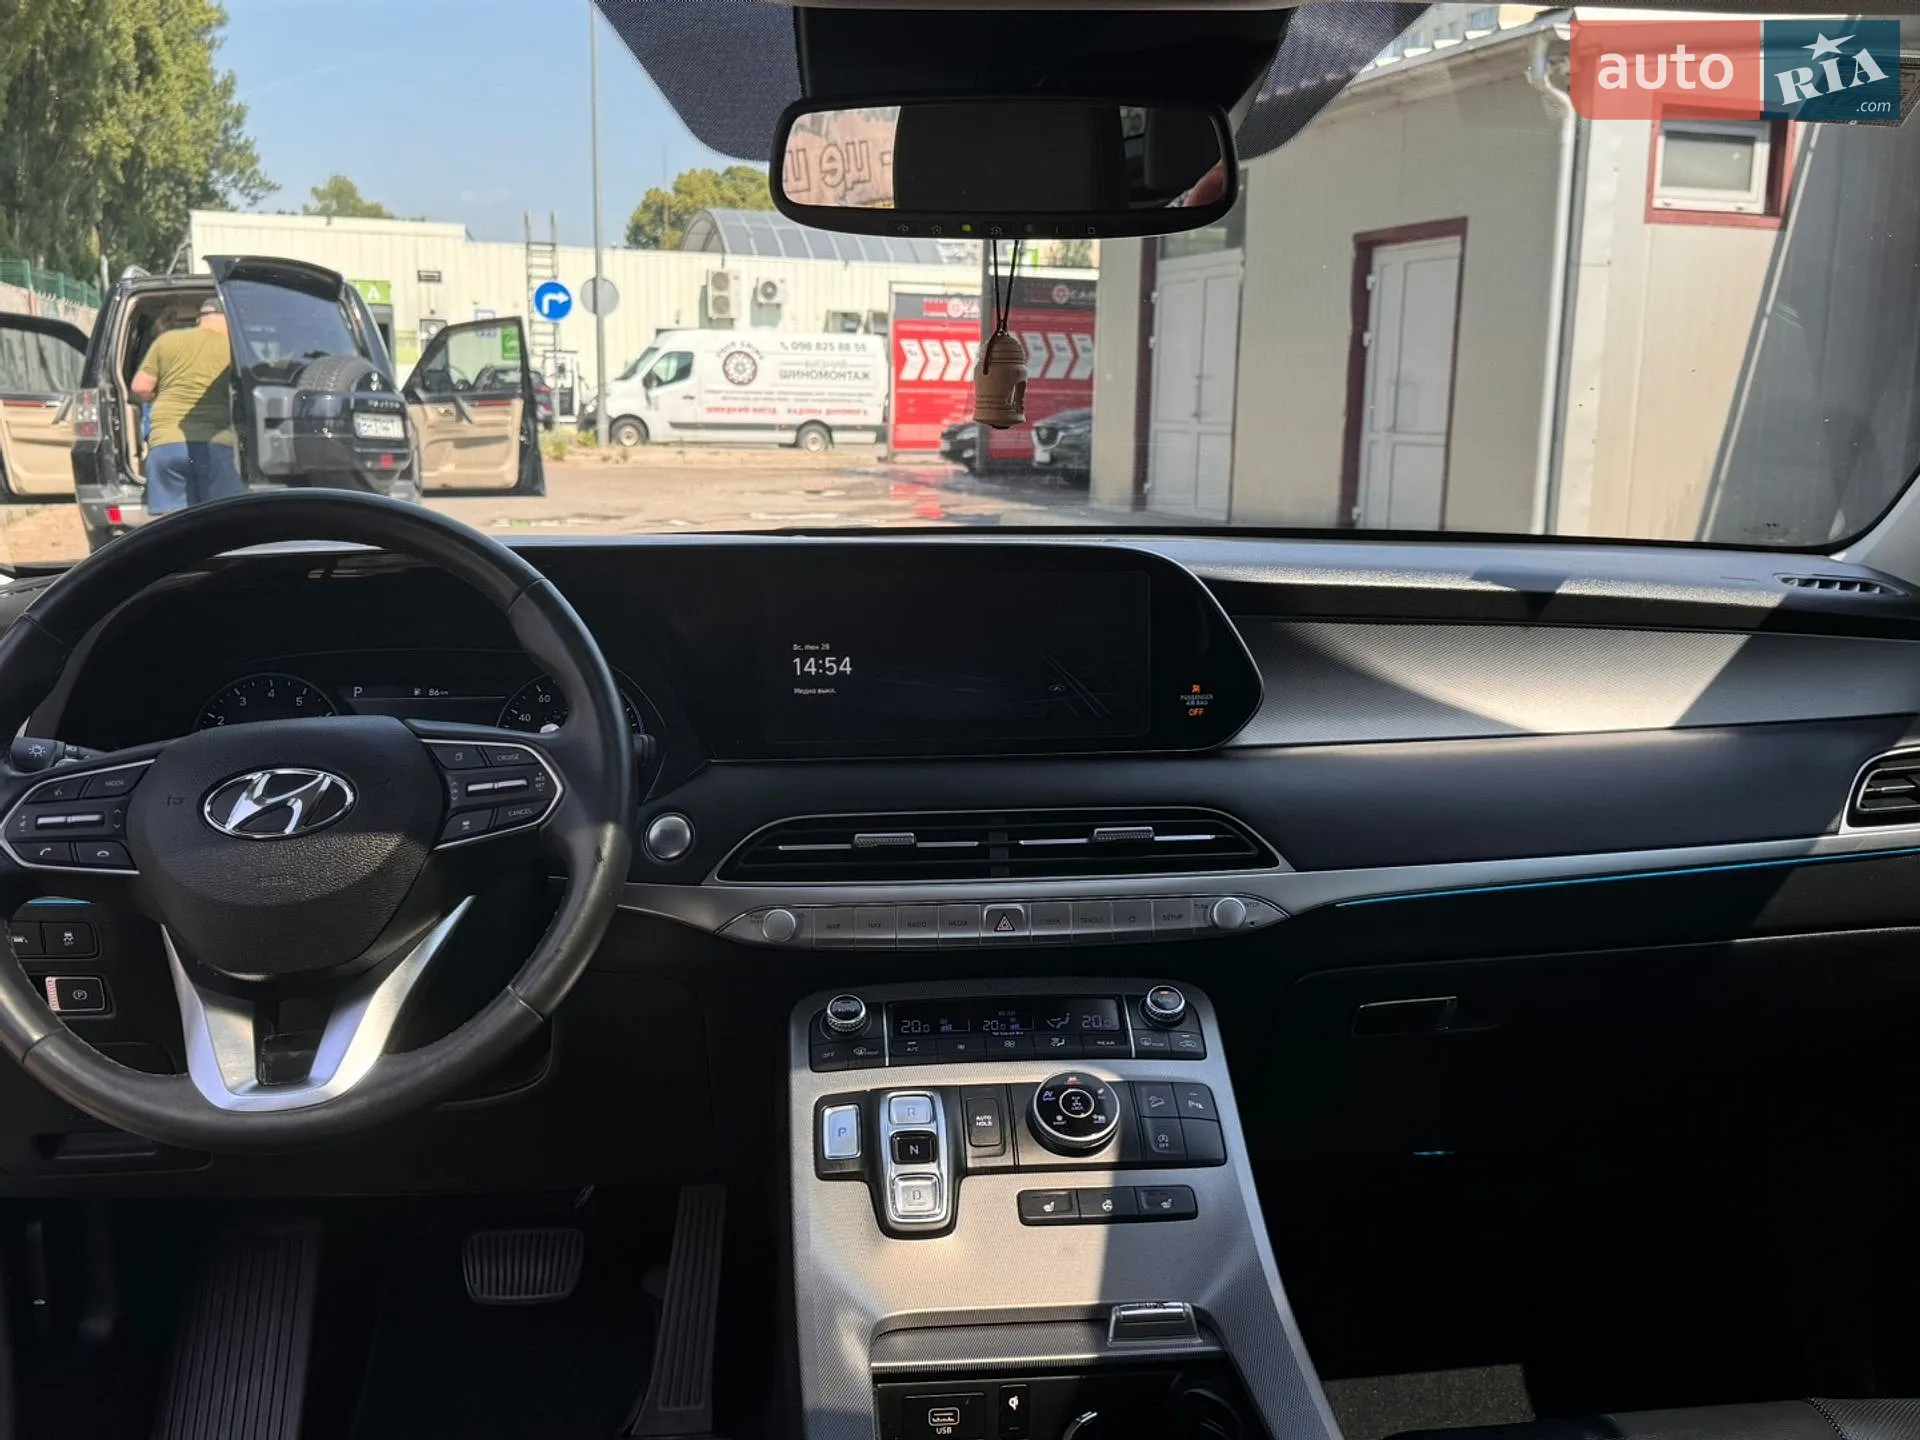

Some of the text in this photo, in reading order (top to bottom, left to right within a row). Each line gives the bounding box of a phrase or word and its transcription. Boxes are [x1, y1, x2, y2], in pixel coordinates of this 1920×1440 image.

[779, 370, 871, 381] ШИНОМОНТАЖ
[792, 656, 853, 676] 14:54
[267, 689, 276, 699] 4
[353, 686, 363, 698] P
[239, 696, 247, 707] 3
[296, 696, 304, 707] 5
[538, 694, 551, 704] 60
[1188, 708, 1204, 716] OFF
[217, 716, 225, 727] 2
[518, 713, 532, 723] 40
[507, 808, 533, 818] CANCEL
[907, 1106, 916, 1117] R
[838, 1127, 847, 1138] P
[909, 1144, 919, 1155] N
[912, 1189, 922, 1201] D
[936, 1426, 952, 1435] USB
